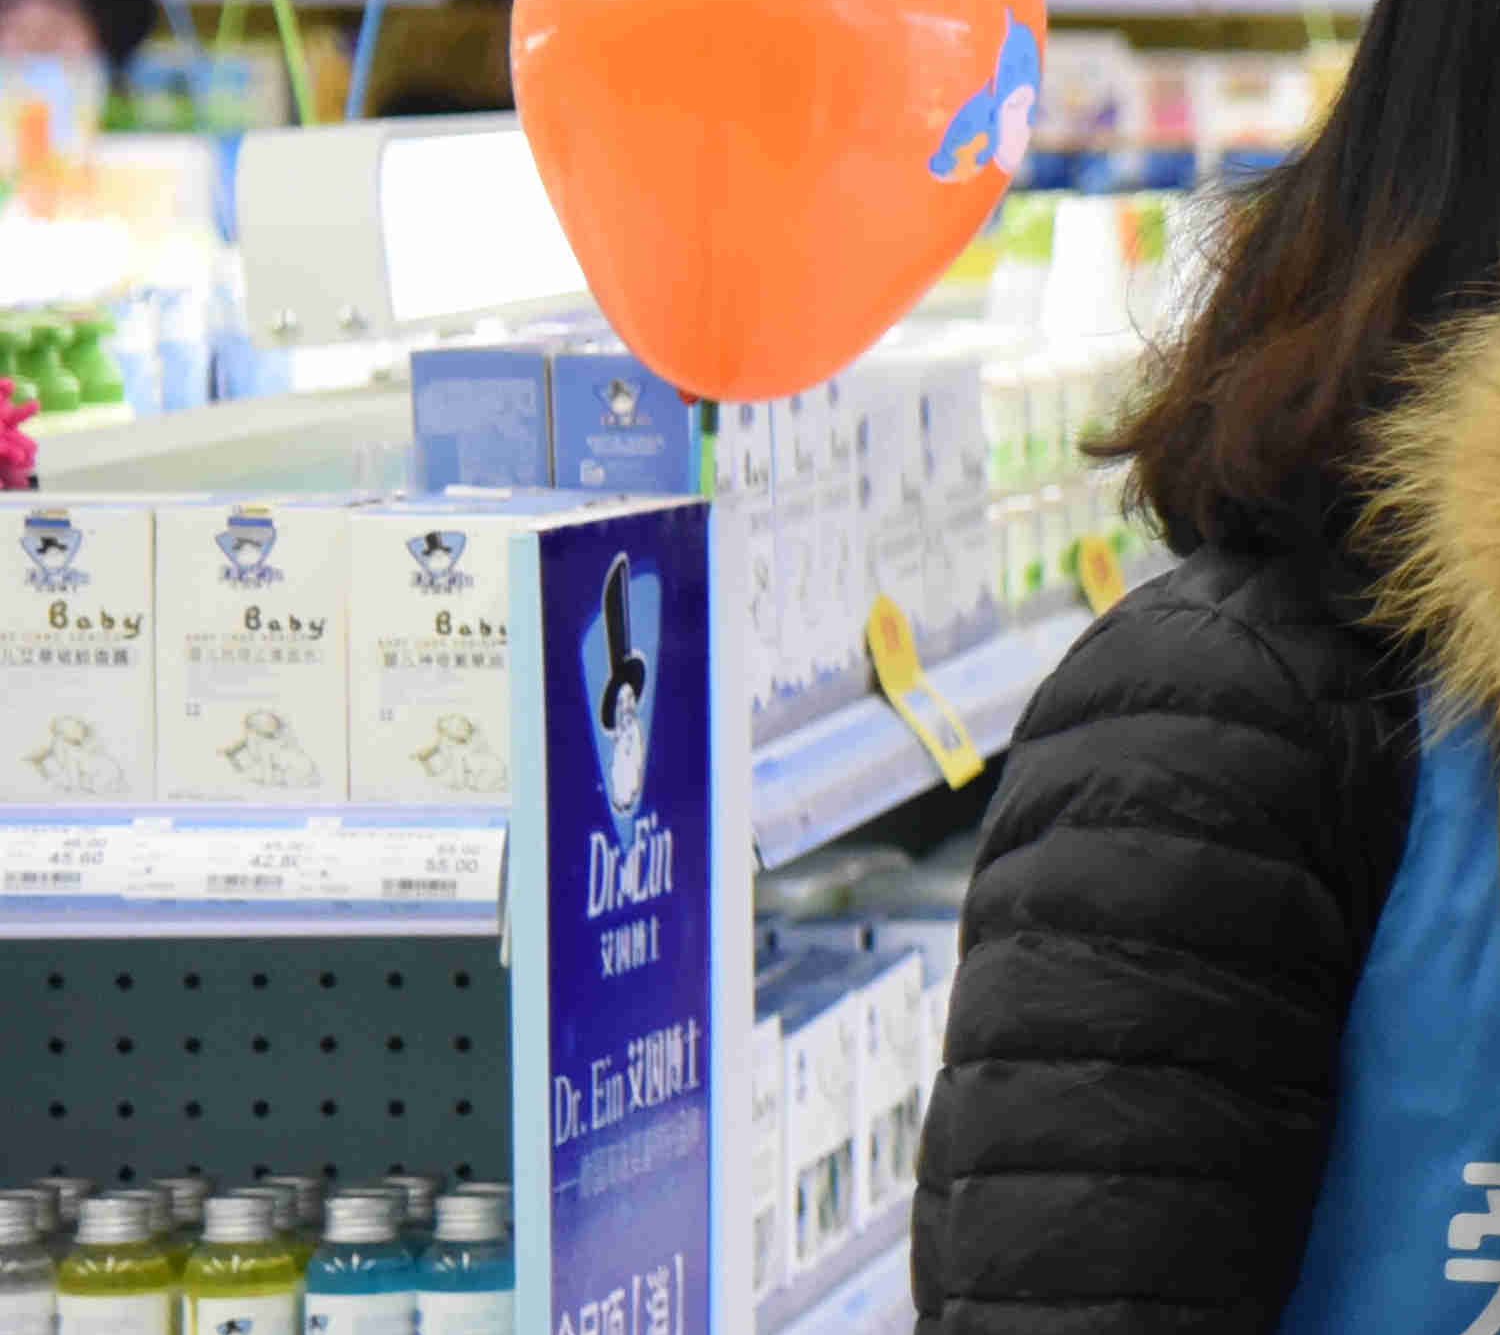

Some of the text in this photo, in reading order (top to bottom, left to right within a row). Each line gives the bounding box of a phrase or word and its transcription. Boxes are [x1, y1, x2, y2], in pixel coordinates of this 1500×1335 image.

[49, 599, 143, 640] Baby
[244, 605, 326, 641] Baby
[555, 1075, 588, 1147] Dr.
[591, 1055, 625, 1131] Ein
